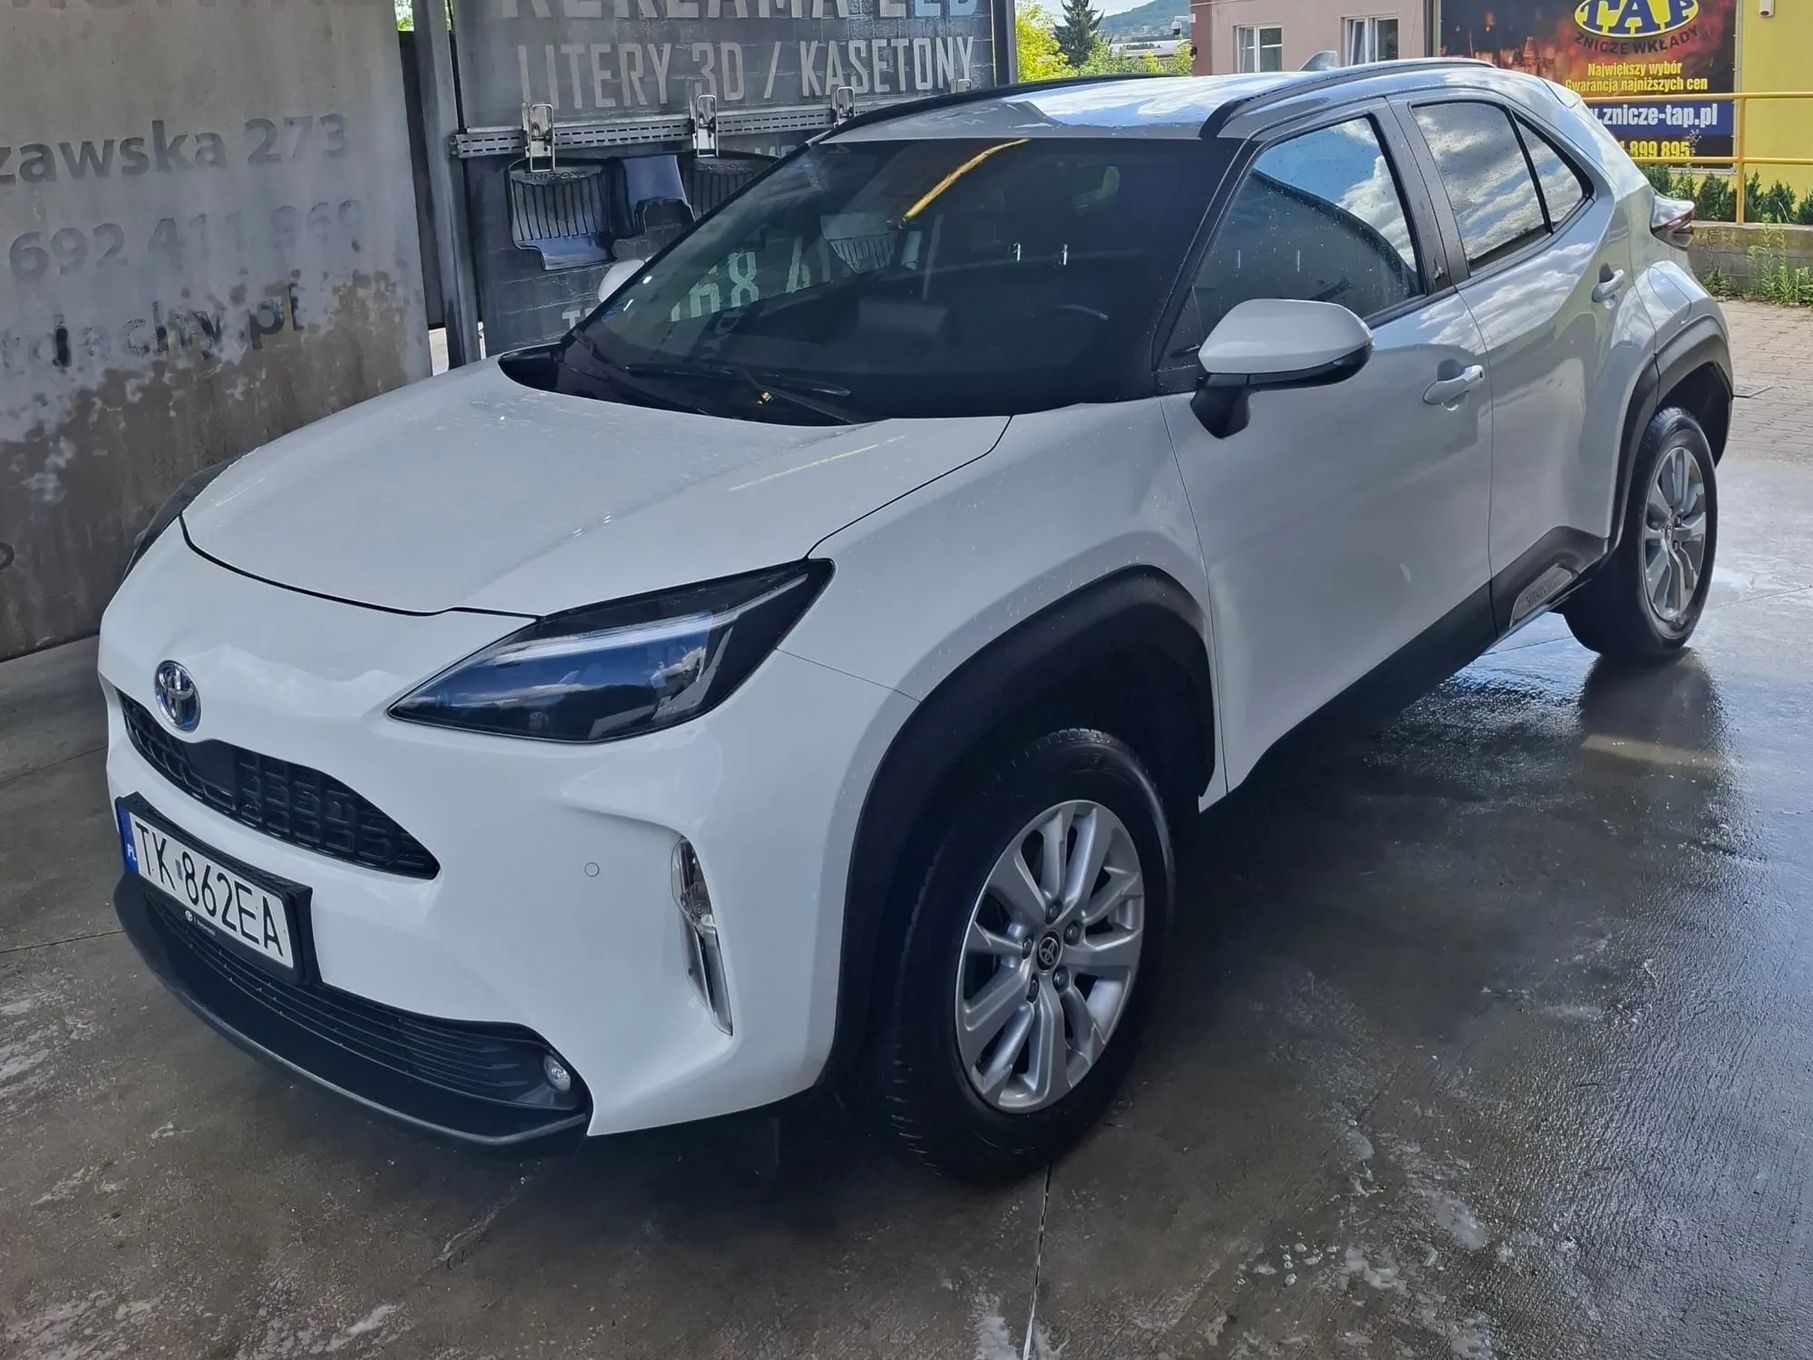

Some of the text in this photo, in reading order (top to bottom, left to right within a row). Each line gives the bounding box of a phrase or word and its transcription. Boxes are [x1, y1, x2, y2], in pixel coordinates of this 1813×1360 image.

[1574, 23, 1699, 55] ZNICZE WKŁADY
[691, 42, 744, 101] 3D
[800, 36, 974, 97] KASETONY
[1587, 59, 1683, 77] Największy wybór
[1621, 77, 1684, 93] najniższych
[1686, 77, 1708, 91] cen
[245, 113, 347, 166] 273
[1629, 140, 1658, 157] 899
[1660, 140, 1692, 157] 895
[9, 222, 129, 279] 692
[135, 821, 284, 957] TK 862EA
